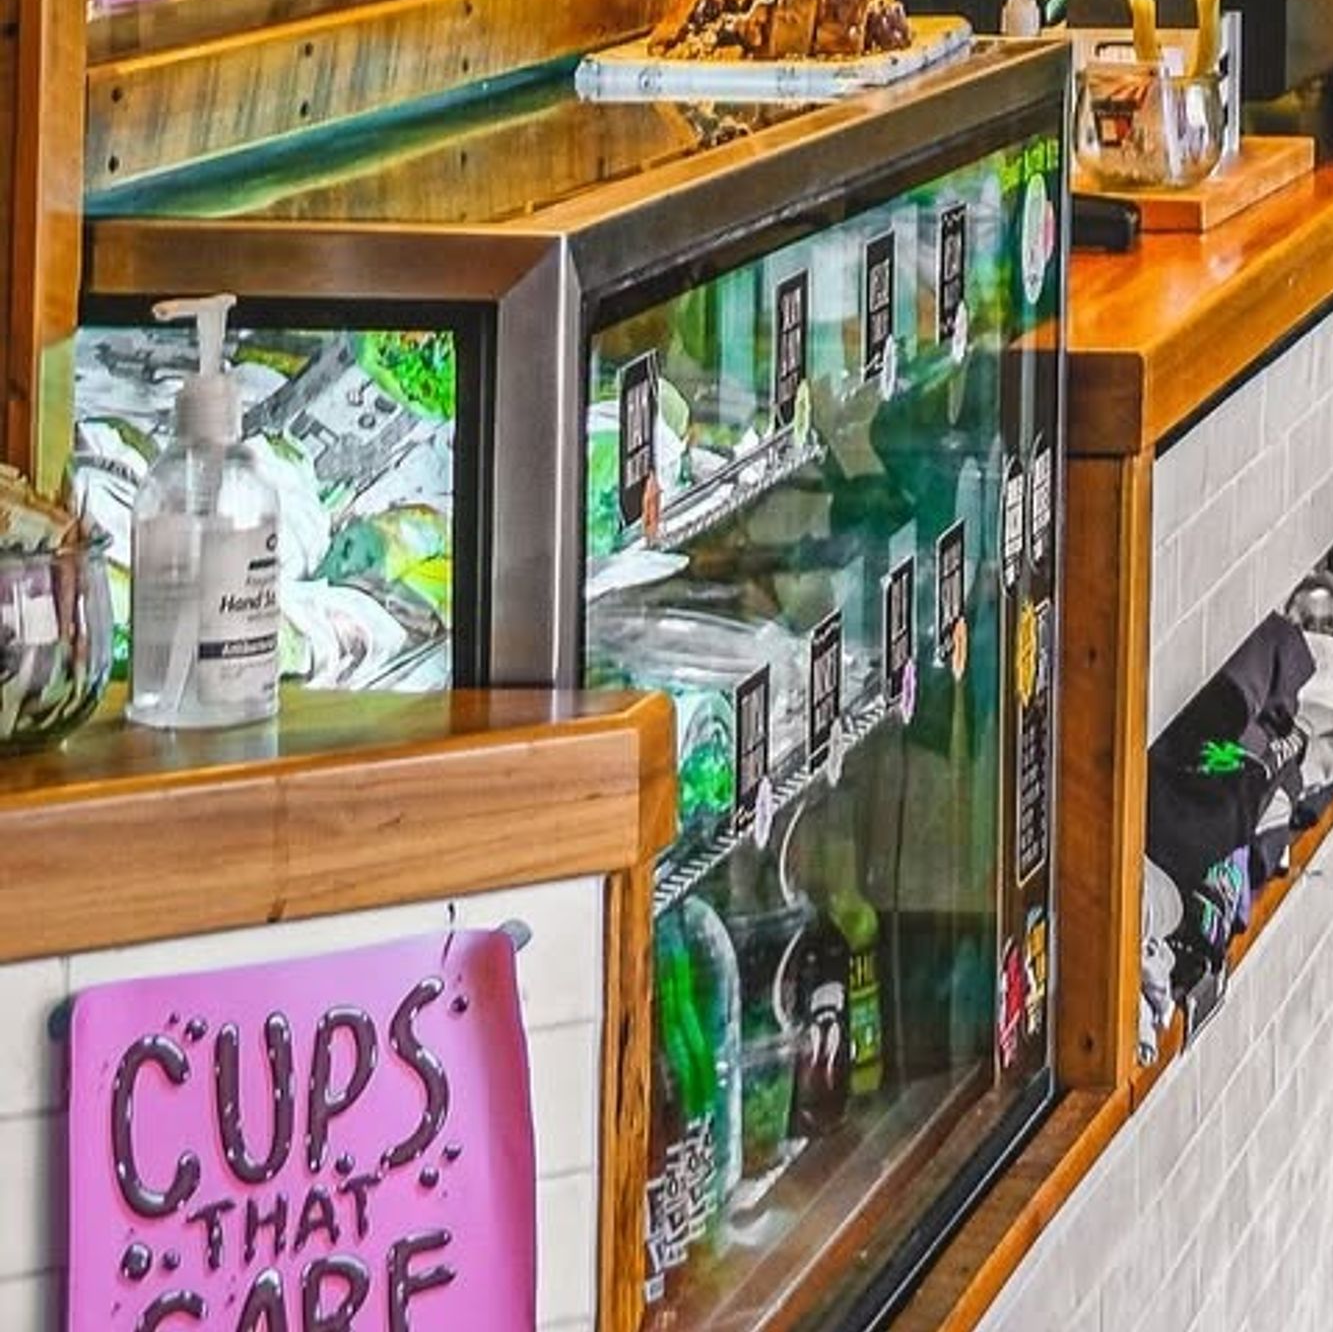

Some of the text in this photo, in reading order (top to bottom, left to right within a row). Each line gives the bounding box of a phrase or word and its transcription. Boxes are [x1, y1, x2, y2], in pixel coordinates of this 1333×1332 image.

[219, 592, 261, 614] Hand
[109, 975, 451, 1219] CUPS
[187, 1174, 380, 1270] THAT
[134, 1228, 457, 1332] CARE
